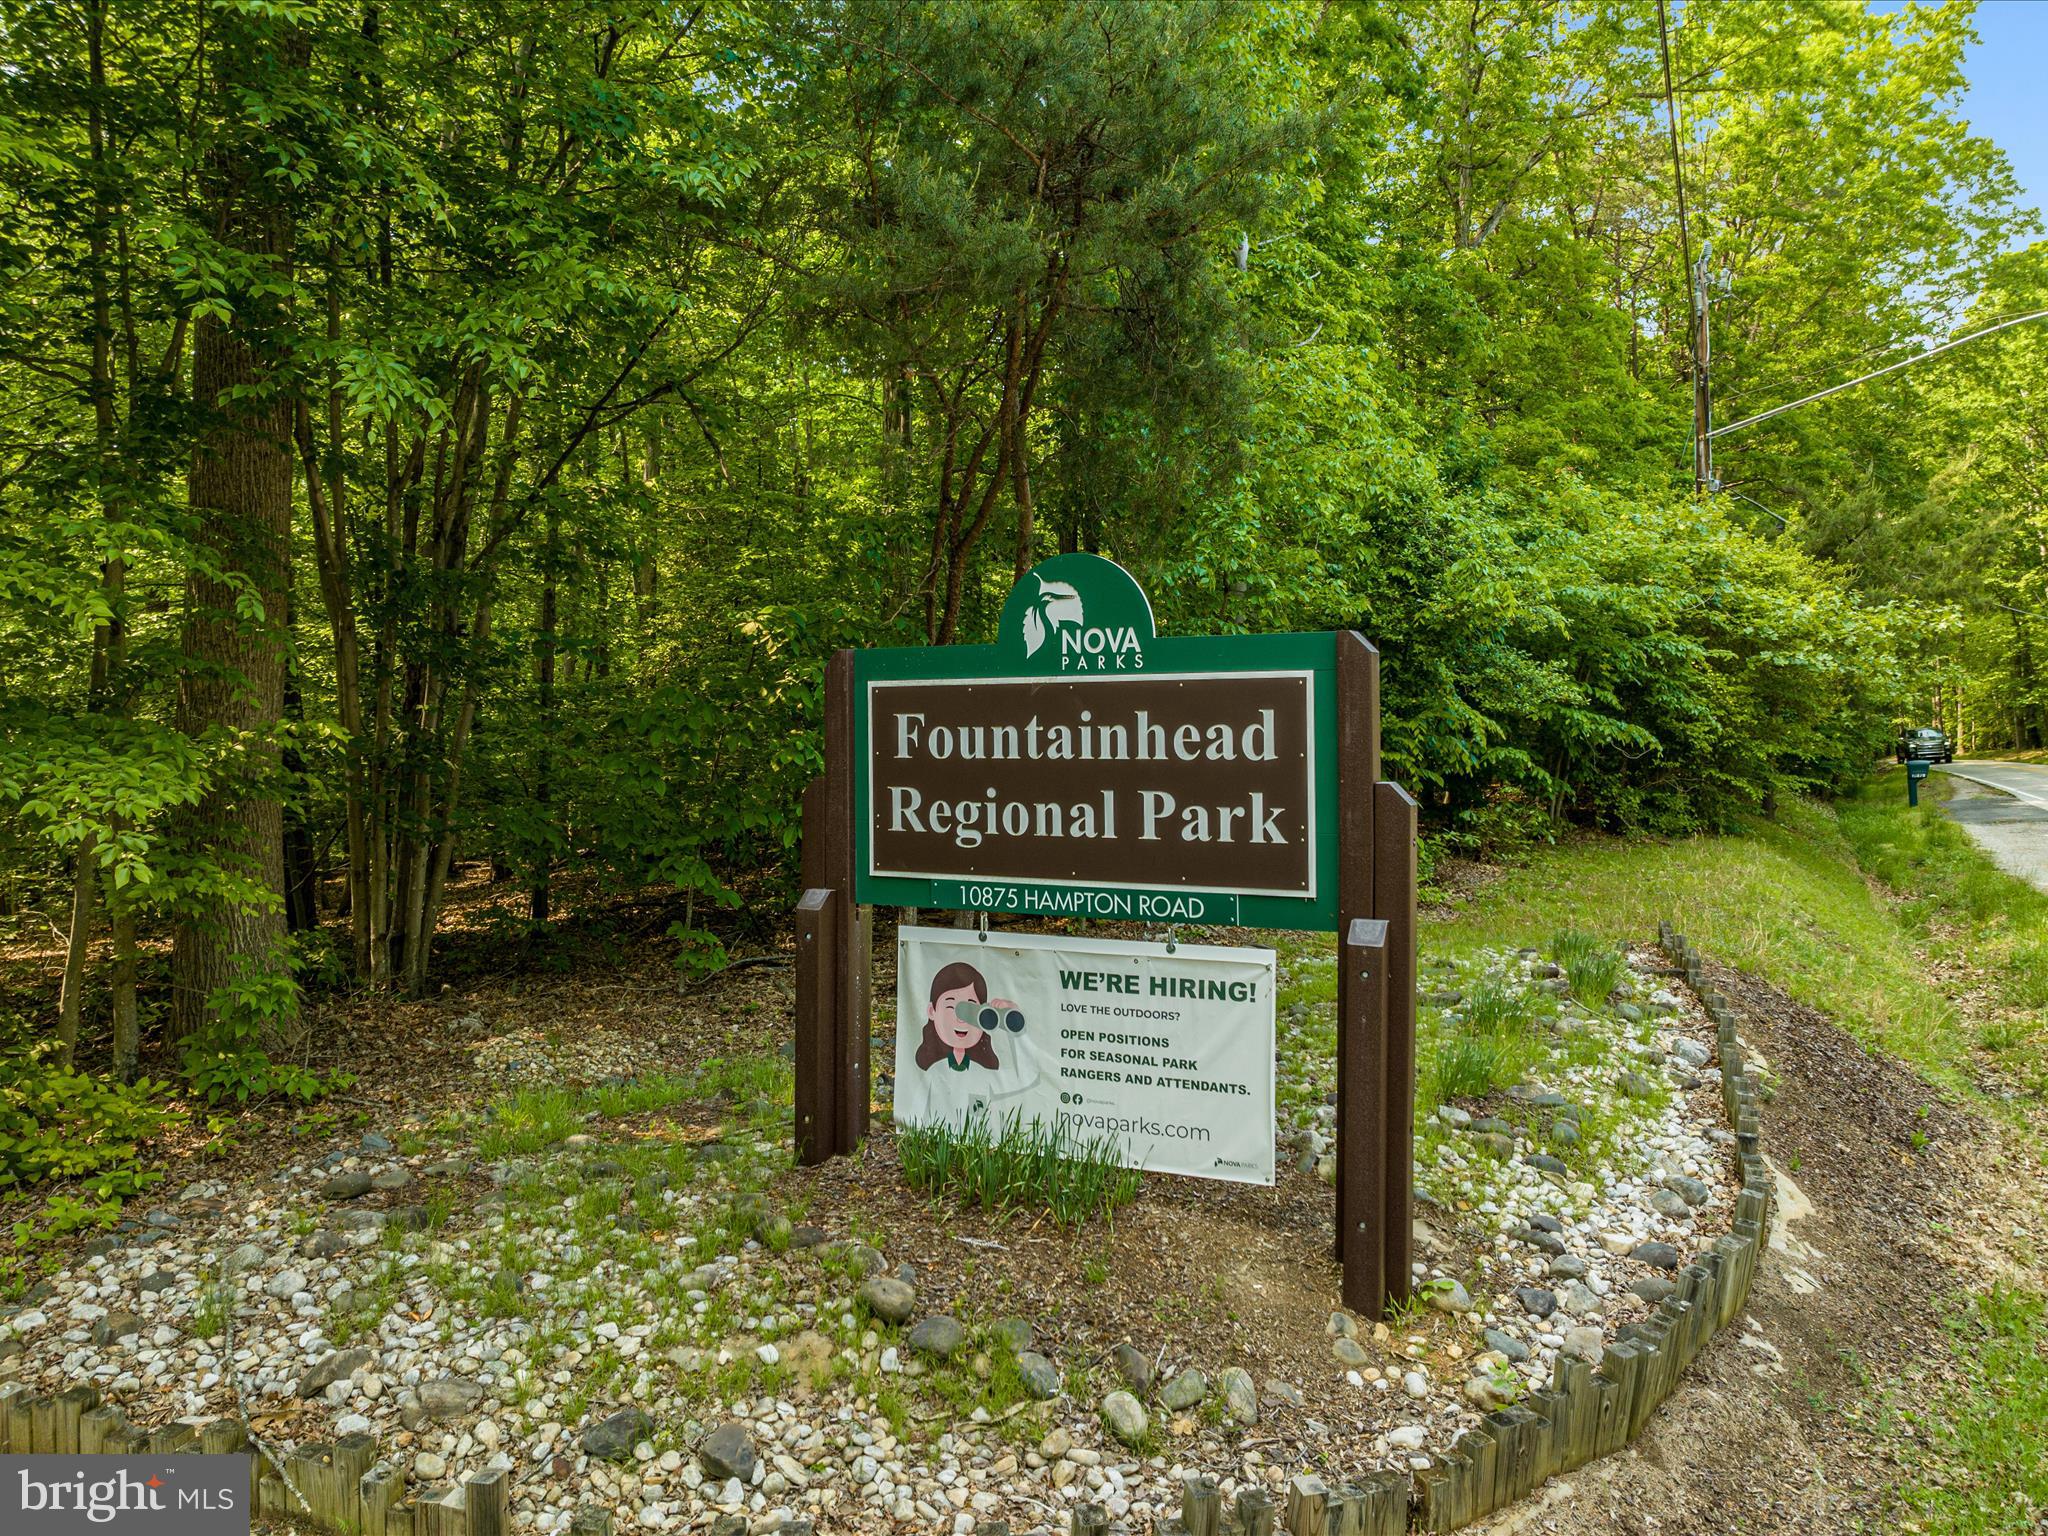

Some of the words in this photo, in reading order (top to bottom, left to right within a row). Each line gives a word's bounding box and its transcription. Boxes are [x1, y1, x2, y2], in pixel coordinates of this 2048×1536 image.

[1062, 627, 1142, 654] NOVA
[1062, 654, 1143, 670] PARKS
[893, 709, 1279, 761] Fountainhead
[887, 786, 1118, 848] Regional
[1138, 790, 1289, 844] Park
[959, 885, 1018, 909] 10875
[1024, 890, 1131, 916] HAMPTON
[1138, 895, 1205, 919] ROAD
[1059, 970, 1140, 995] WE’RE
[1149, 975, 1257, 1003] HIRING!
[1060, 1003, 1088, 1015] LOVE
[1090, 1005, 1111, 1016] THE
[1113, 1007, 1181, 1021] OUTDOORS?
[1060, 1029, 1095, 1042] OPEN
[1098, 1032, 1170, 1048] POSITIONS
[1060, 1048, 1086, 1060] FOR
[1089, 1050, 1158, 1067] SEASONAL
[1162, 1057, 1198, 1071] PARK
[1060, 1067, 1121, 1083] RANGERS
[1125, 1073, 1153, 1086] AND
[1156, 1076, 1251, 1096] ATTENDANTS.
[1060, 1111, 1210, 1142] novaparks.com
